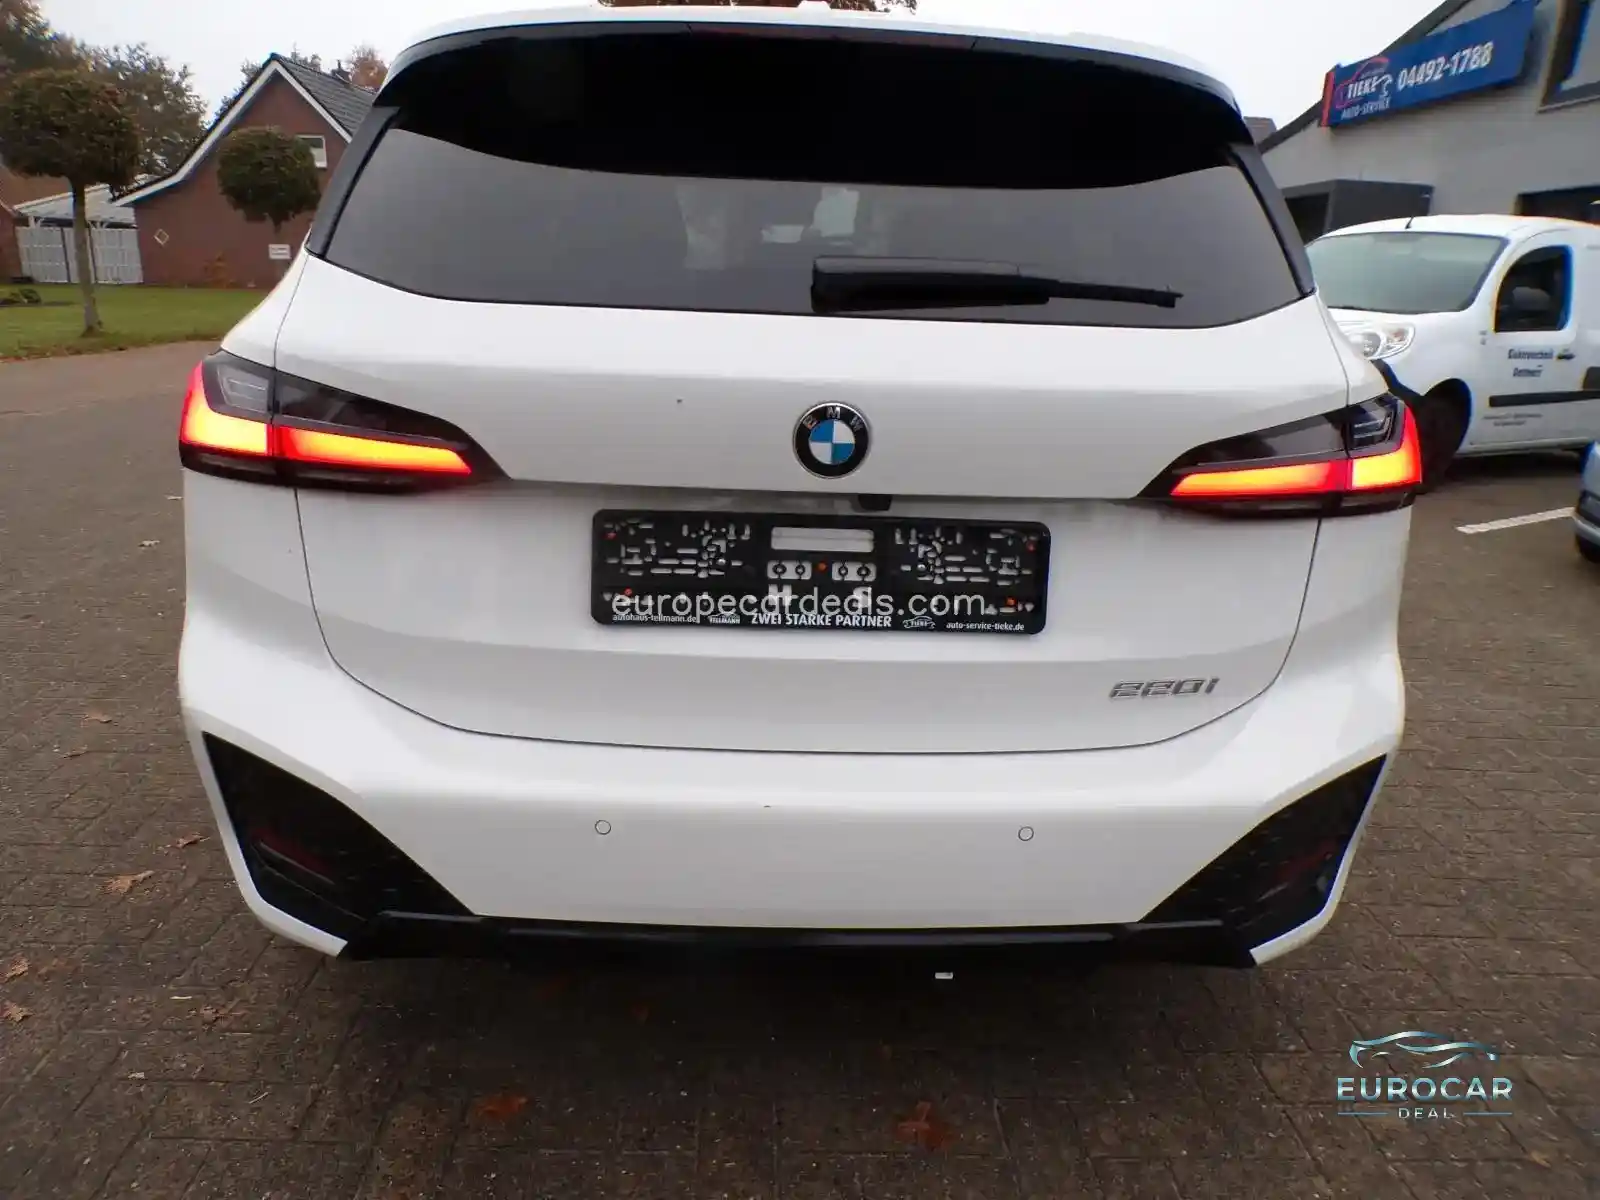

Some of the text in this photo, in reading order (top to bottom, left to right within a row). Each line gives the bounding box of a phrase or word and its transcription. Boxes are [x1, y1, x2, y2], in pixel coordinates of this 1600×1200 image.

[1397, 41, 1494, 91] 04492-1788
[1348, 75, 1380, 99] TIEKE
[803, 406, 864, 431] BMW
[751, 613, 893, 628] ZWEI STARKE PARTNER
[946, 621, 1025, 631] auto-service-tieke.de
